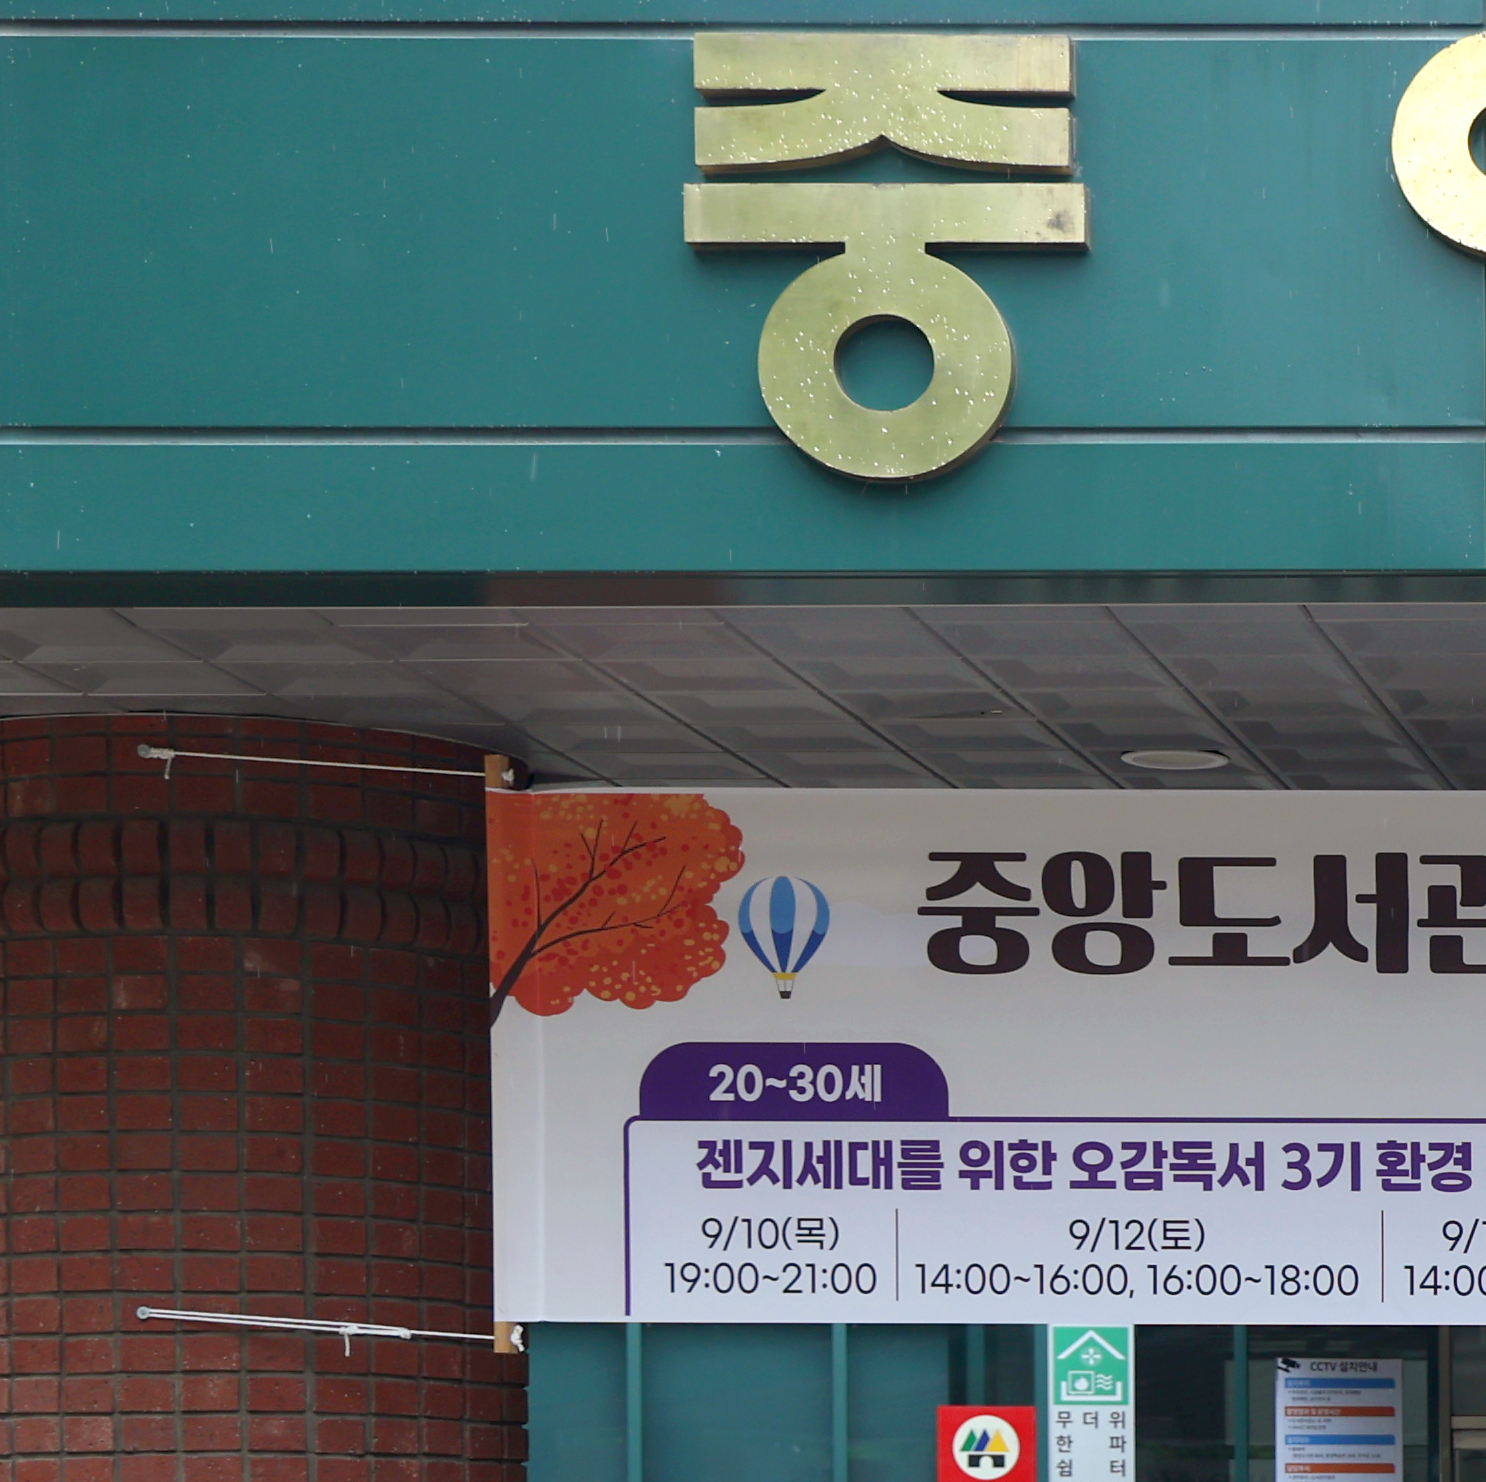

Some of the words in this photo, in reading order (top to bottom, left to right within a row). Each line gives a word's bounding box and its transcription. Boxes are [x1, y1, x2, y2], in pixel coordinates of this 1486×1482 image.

[709, 1064, 881, 1102] 20~30세
[697, 1139, 944, 1190] 젠지세대를
[959, 1139, 1057, 1190] 위한
[1070, 1141, 1264, 1191] 오감독서
[1282, 1142, 1361, 1191] 3기
[1376, 1140, 1472, 1192] 환경
[702, 1216, 839, 1251] 9/10(목)
[1069, 1218, 1204, 1252] 9/12(토)
[665, 1262, 876, 1294] 19:00~21:00
[915, 1264, 1133, 1298] 14:00~16:00,
[1147, 1264, 1358, 1296] 16:00~18:00
[1309, 1361, 1336, 1371] CCTV
[1055, 1410, 1126, 1430] 무더위
